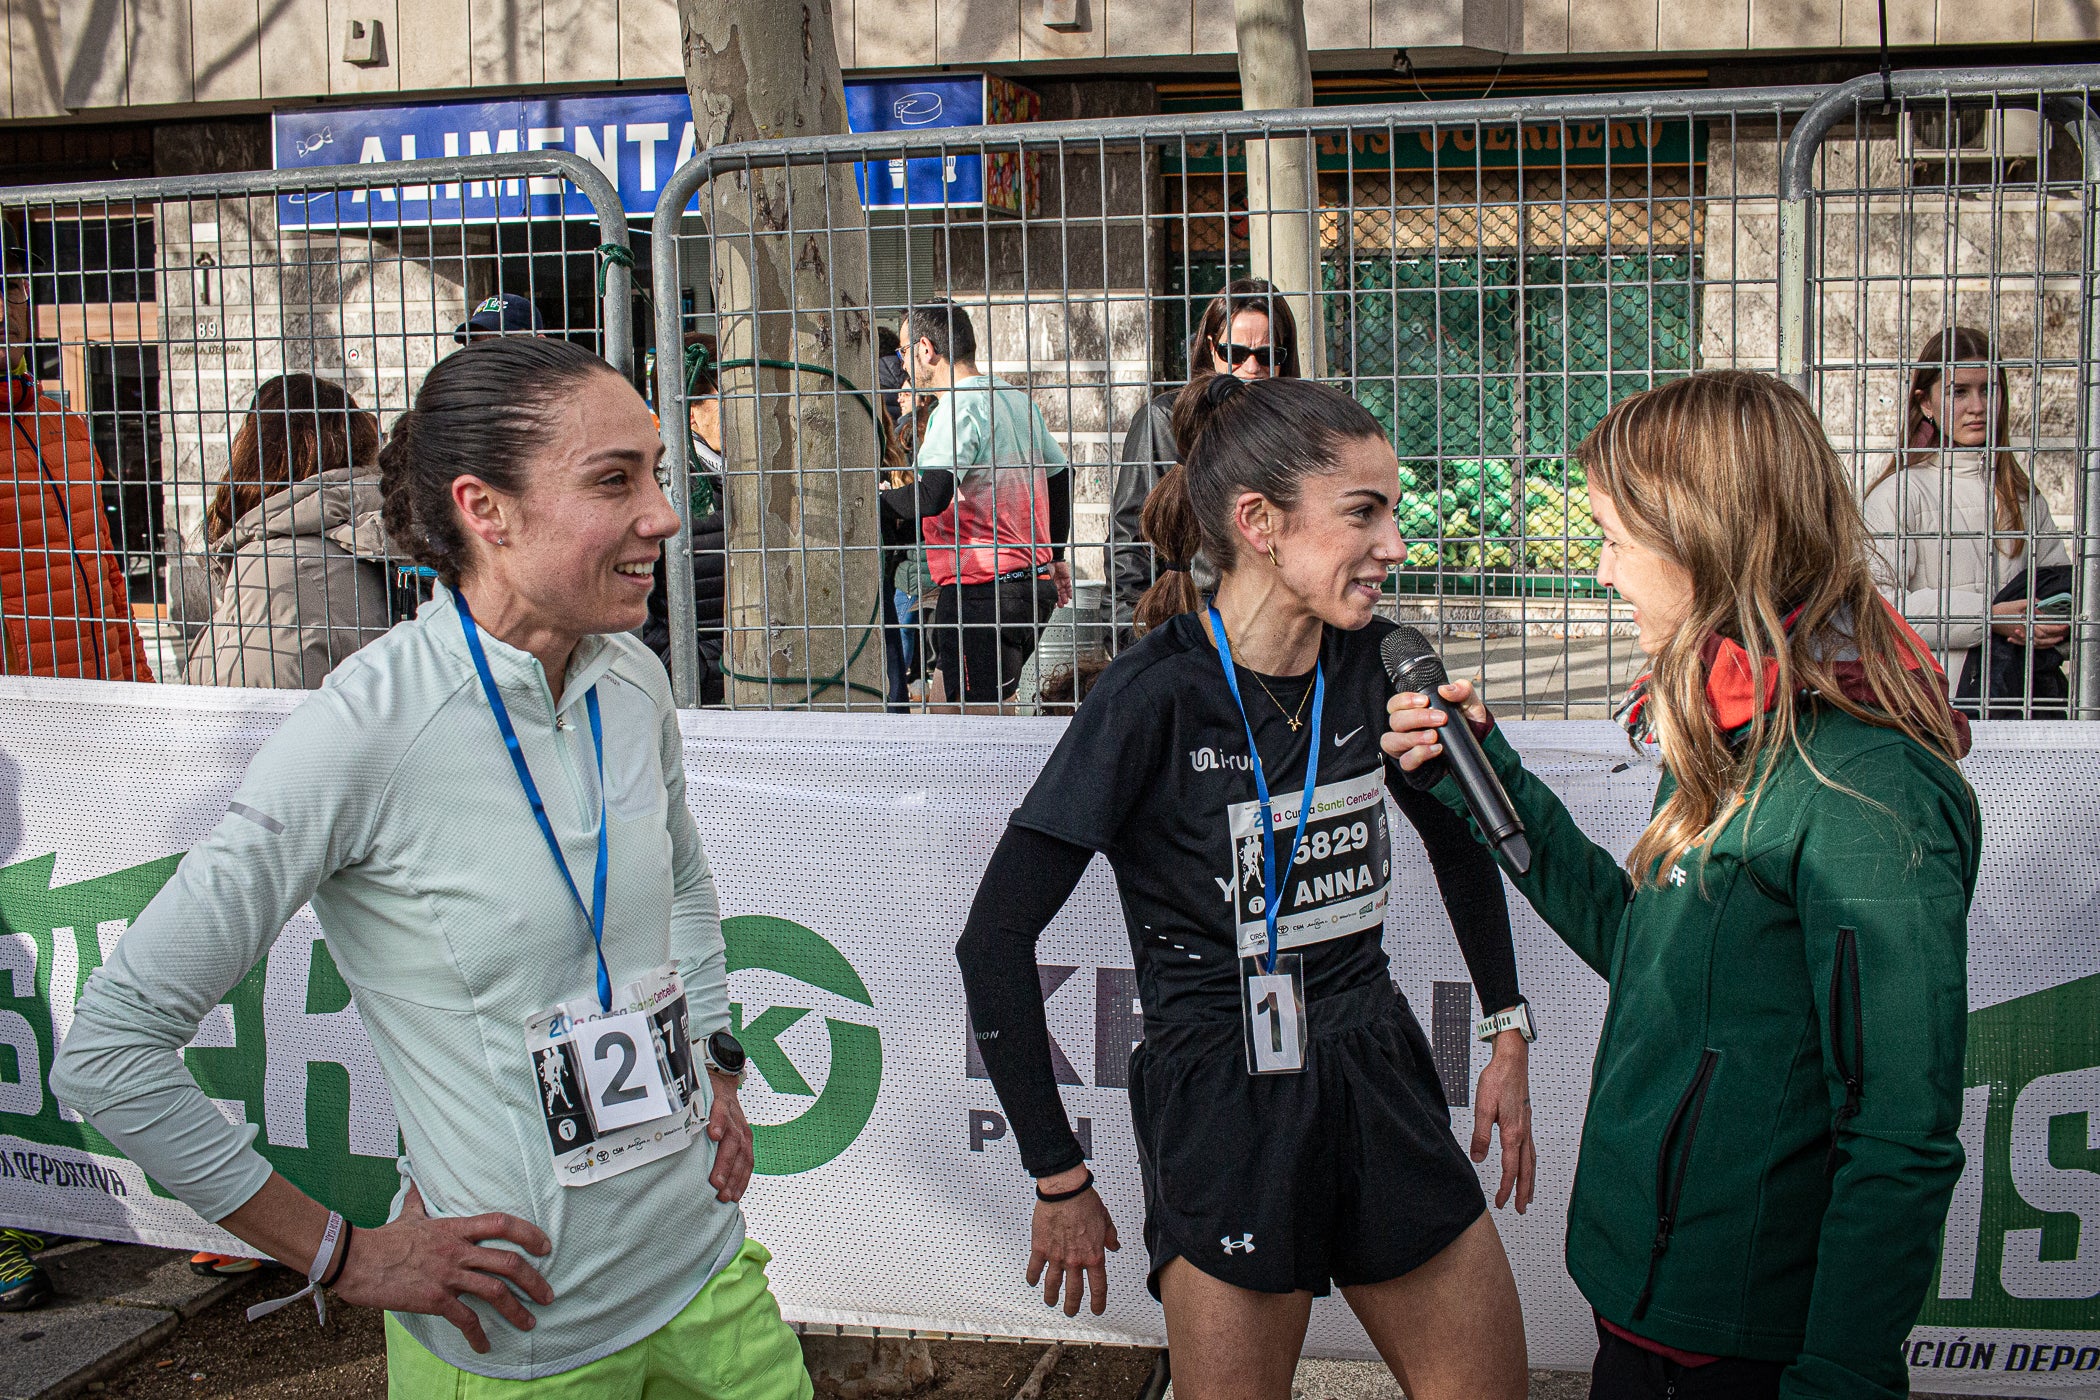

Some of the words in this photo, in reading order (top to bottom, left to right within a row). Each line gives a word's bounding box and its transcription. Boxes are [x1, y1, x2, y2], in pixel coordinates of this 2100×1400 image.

[198, 322, 218, 338] 89
[1284, 806, 1315, 820] Cura
[1317, 797, 1345, 814] Santi
[1292, 821, 1369, 863] 5829
[1293, 864, 1374, 908] ANNA
[1256, 991, 1283, 1053] 1
[594, 1031, 649, 1107] 2
[13, 1151, 127, 1197] DEPORTIVA
[570, 1161, 590, 1174] CIRSA
[2004, 1343, 2100, 1372] DEPO
